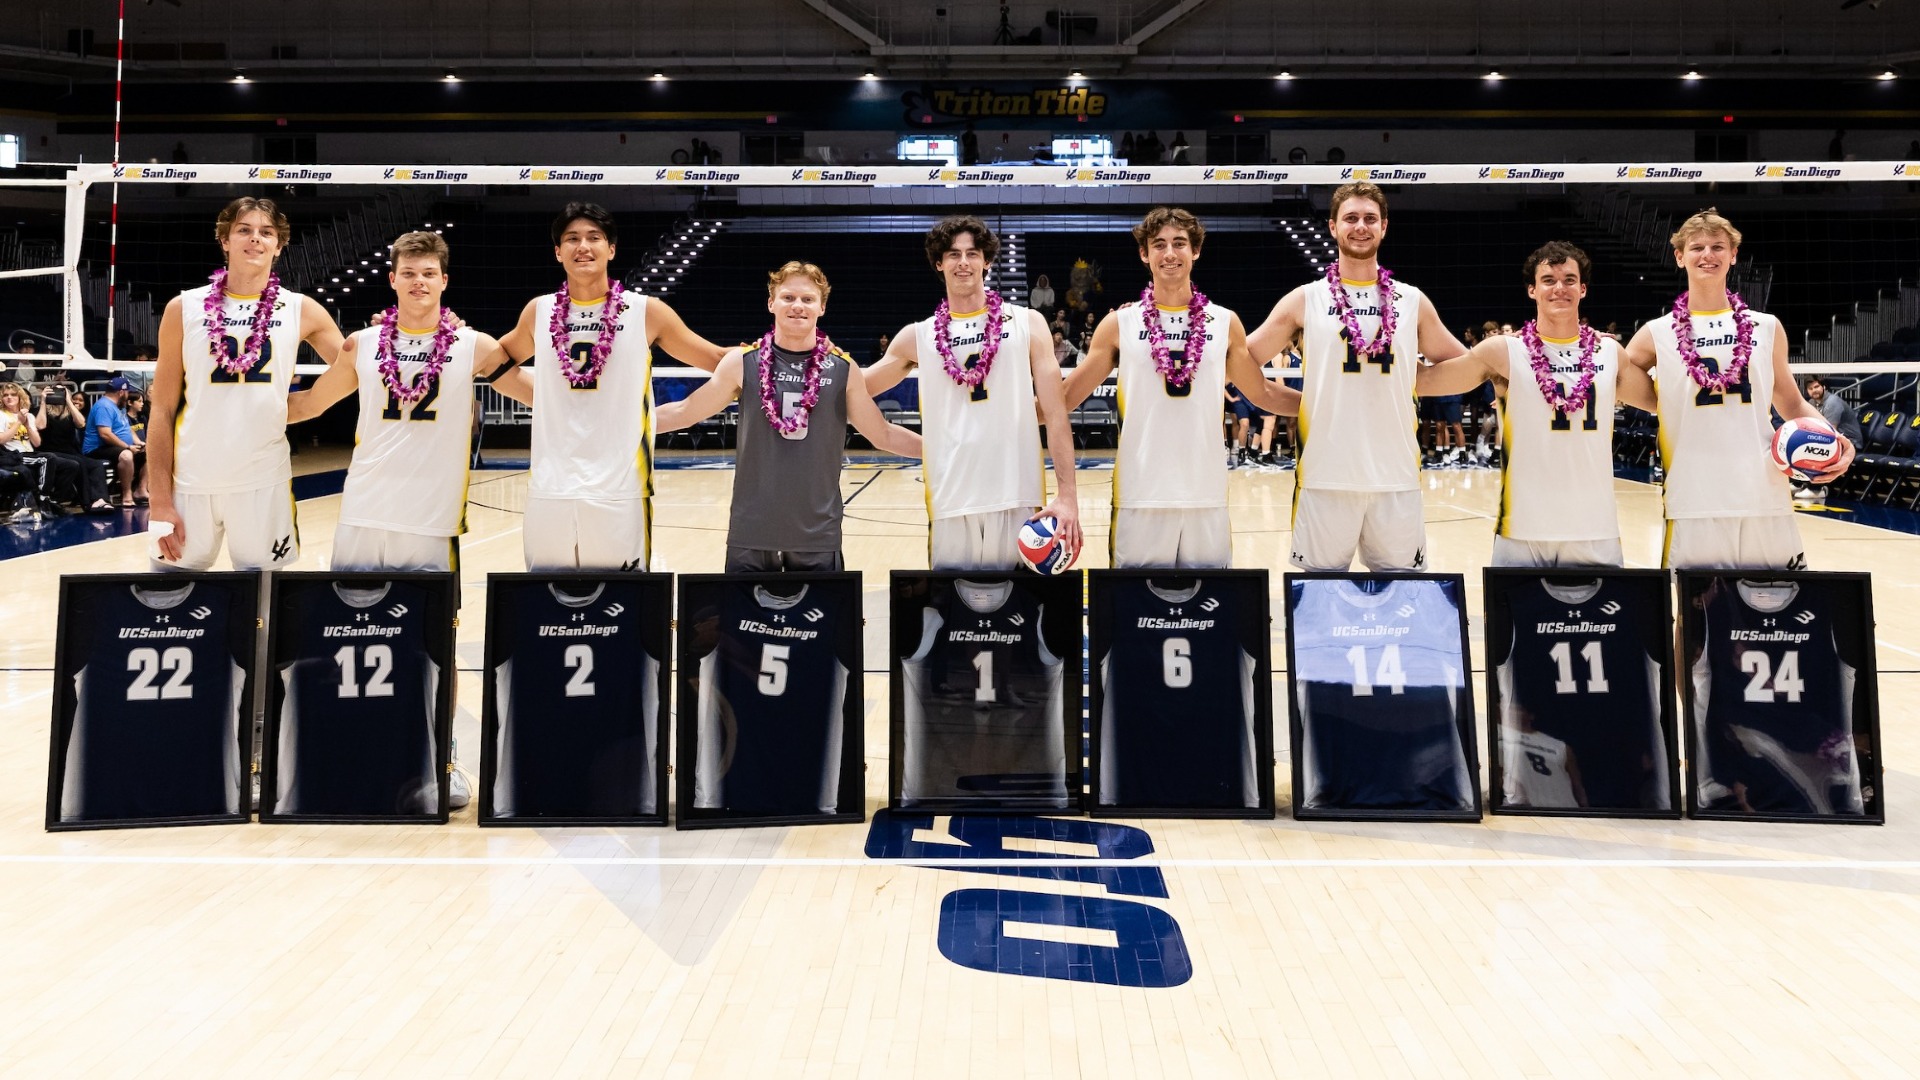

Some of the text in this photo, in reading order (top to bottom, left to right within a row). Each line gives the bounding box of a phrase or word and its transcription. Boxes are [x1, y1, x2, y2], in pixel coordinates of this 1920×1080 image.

[934, 88, 1105, 115] Triton Tide
[210, 334, 272, 383] 22
[570, 342, 598, 389] 2
[1339, 326, 1395, 374] 14
[382, 371, 440, 420] 12
[964, 353, 988, 402] 1
[1695, 357, 1752, 406] 24
[779, 391, 808, 440] 5
[1551, 382, 1597, 430] 11
[1804, 446, 1830, 457] NCAA
[1054, 552, 1072, 571] NCAA
[126, 646, 193, 701] 22
[334, 644, 395, 698] 12
[564, 643, 596, 697] 2
[757, 643, 791, 697] 5
[972, 650, 997, 702] 1
[1162, 637, 1193, 689] 6
[1346, 643, 1407, 697] 14
[1549, 640, 1610, 694] 11
[1740, 650, 1805, 703] 24
